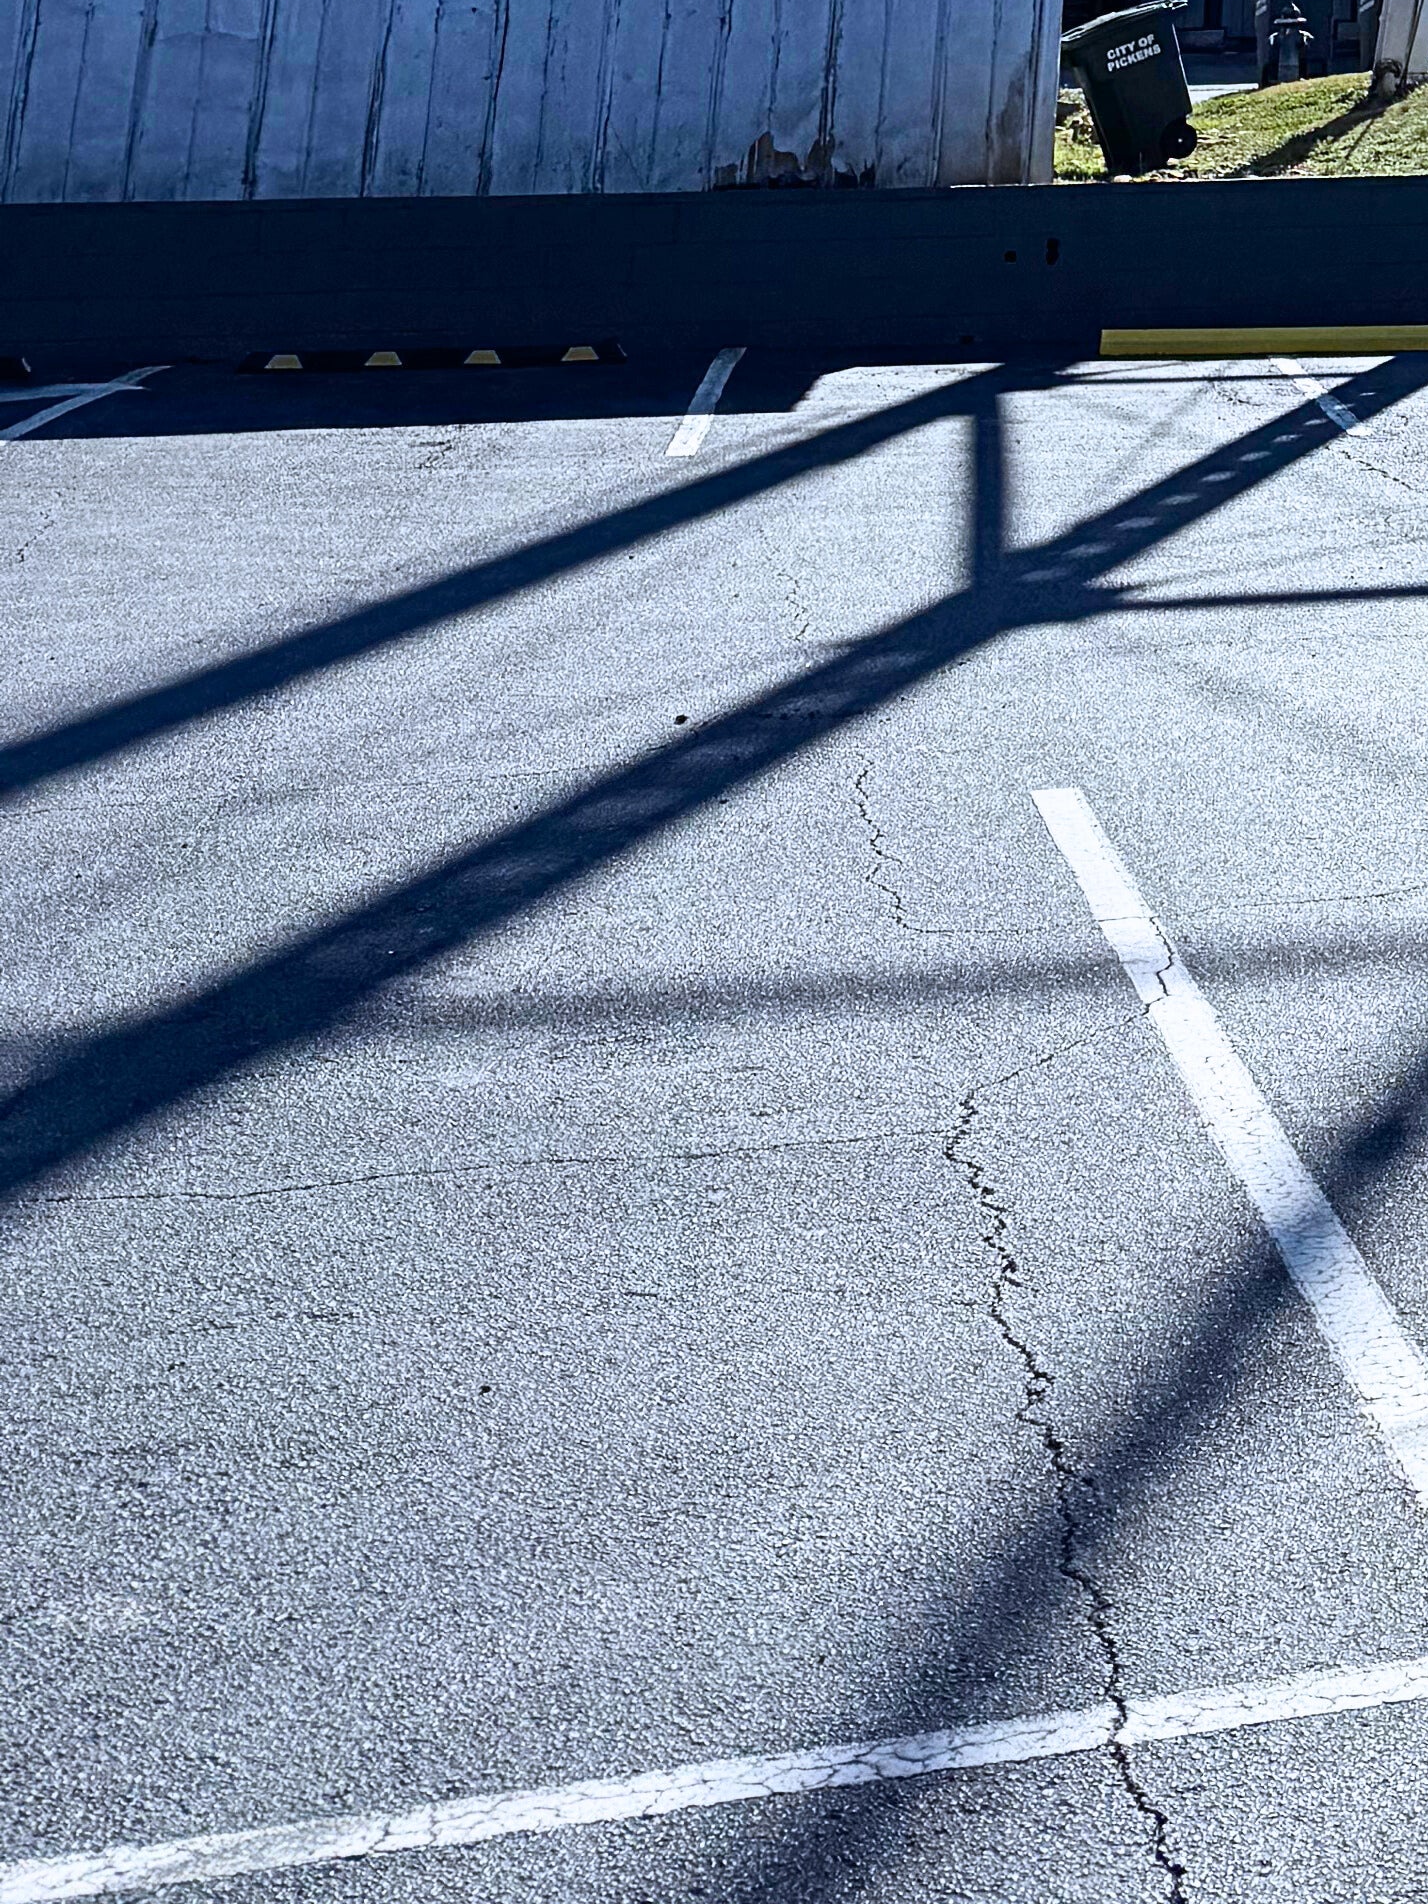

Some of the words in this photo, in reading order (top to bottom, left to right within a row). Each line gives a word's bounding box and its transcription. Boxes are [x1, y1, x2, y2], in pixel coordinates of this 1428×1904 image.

[1106, 39, 1136, 60] CITY
[1138, 33, 1155, 48] OF
[1106, 43, 1162, 72] PICKENS
